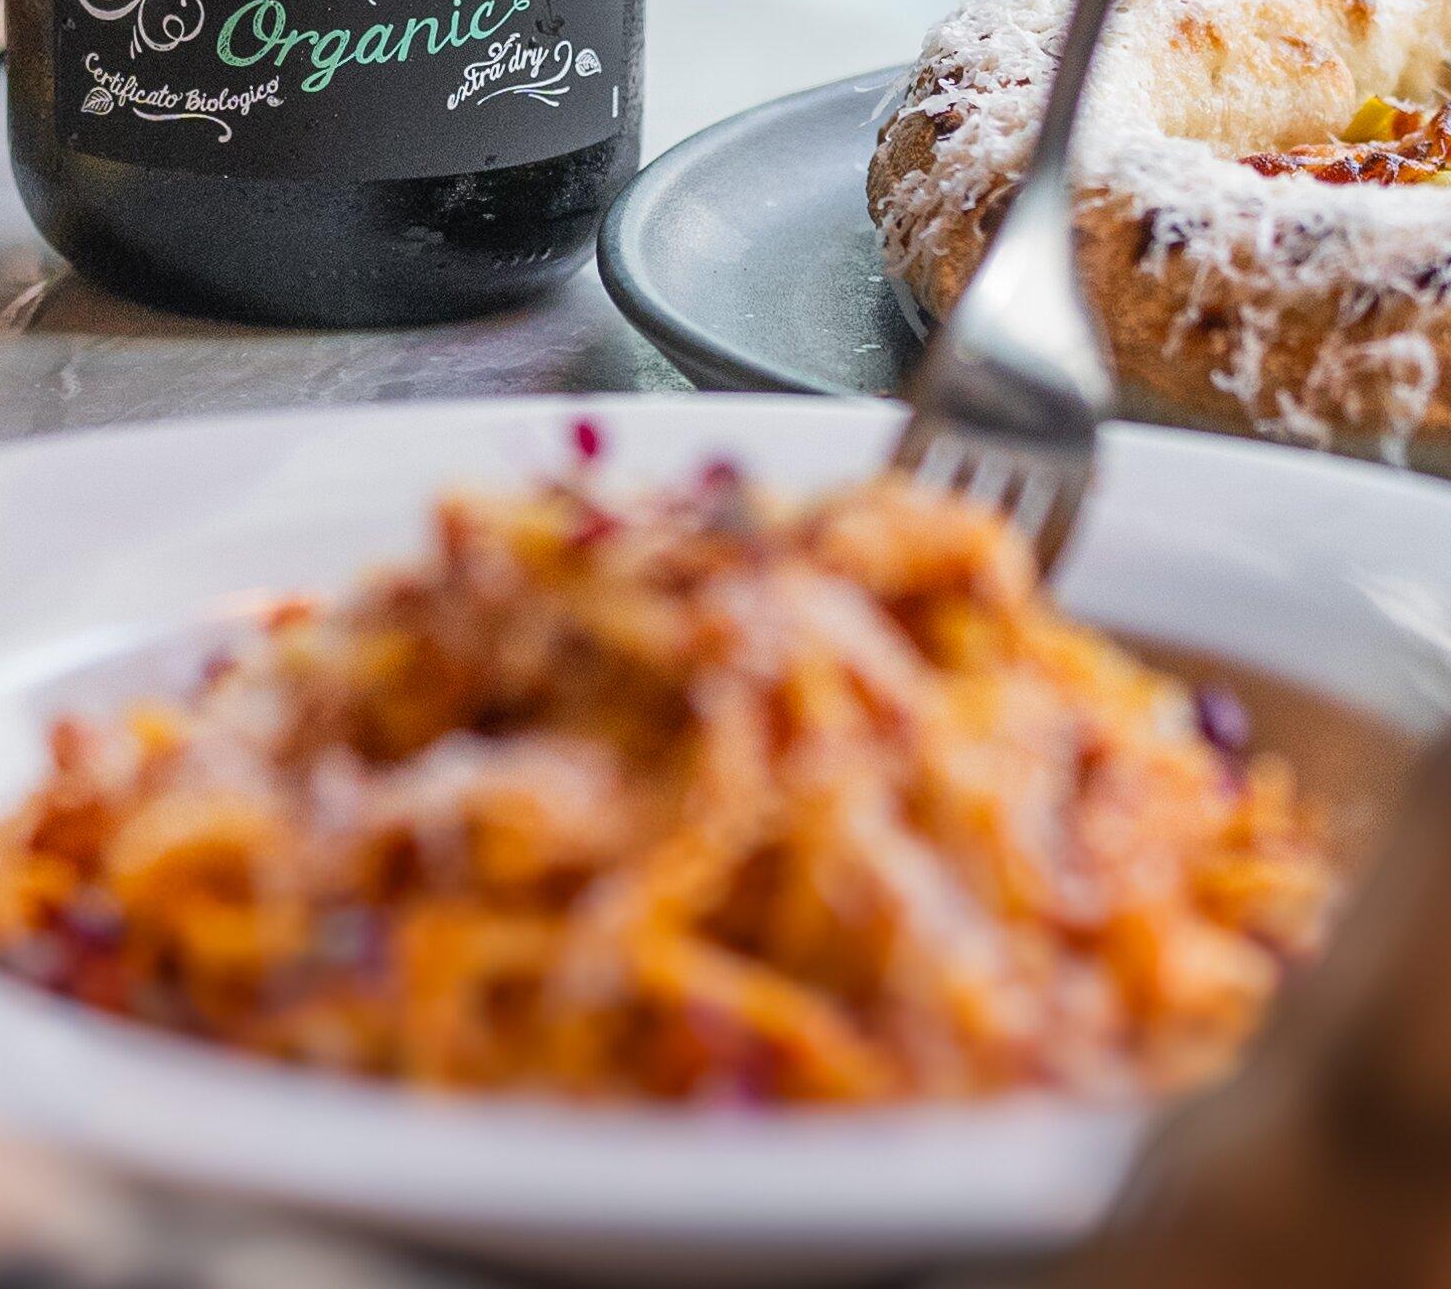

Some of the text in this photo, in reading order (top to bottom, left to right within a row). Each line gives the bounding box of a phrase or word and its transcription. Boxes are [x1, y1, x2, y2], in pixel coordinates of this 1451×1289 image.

[85, 52, 280, 116] Certificato Biologico
[447, 41, 550, 111] extra dry
